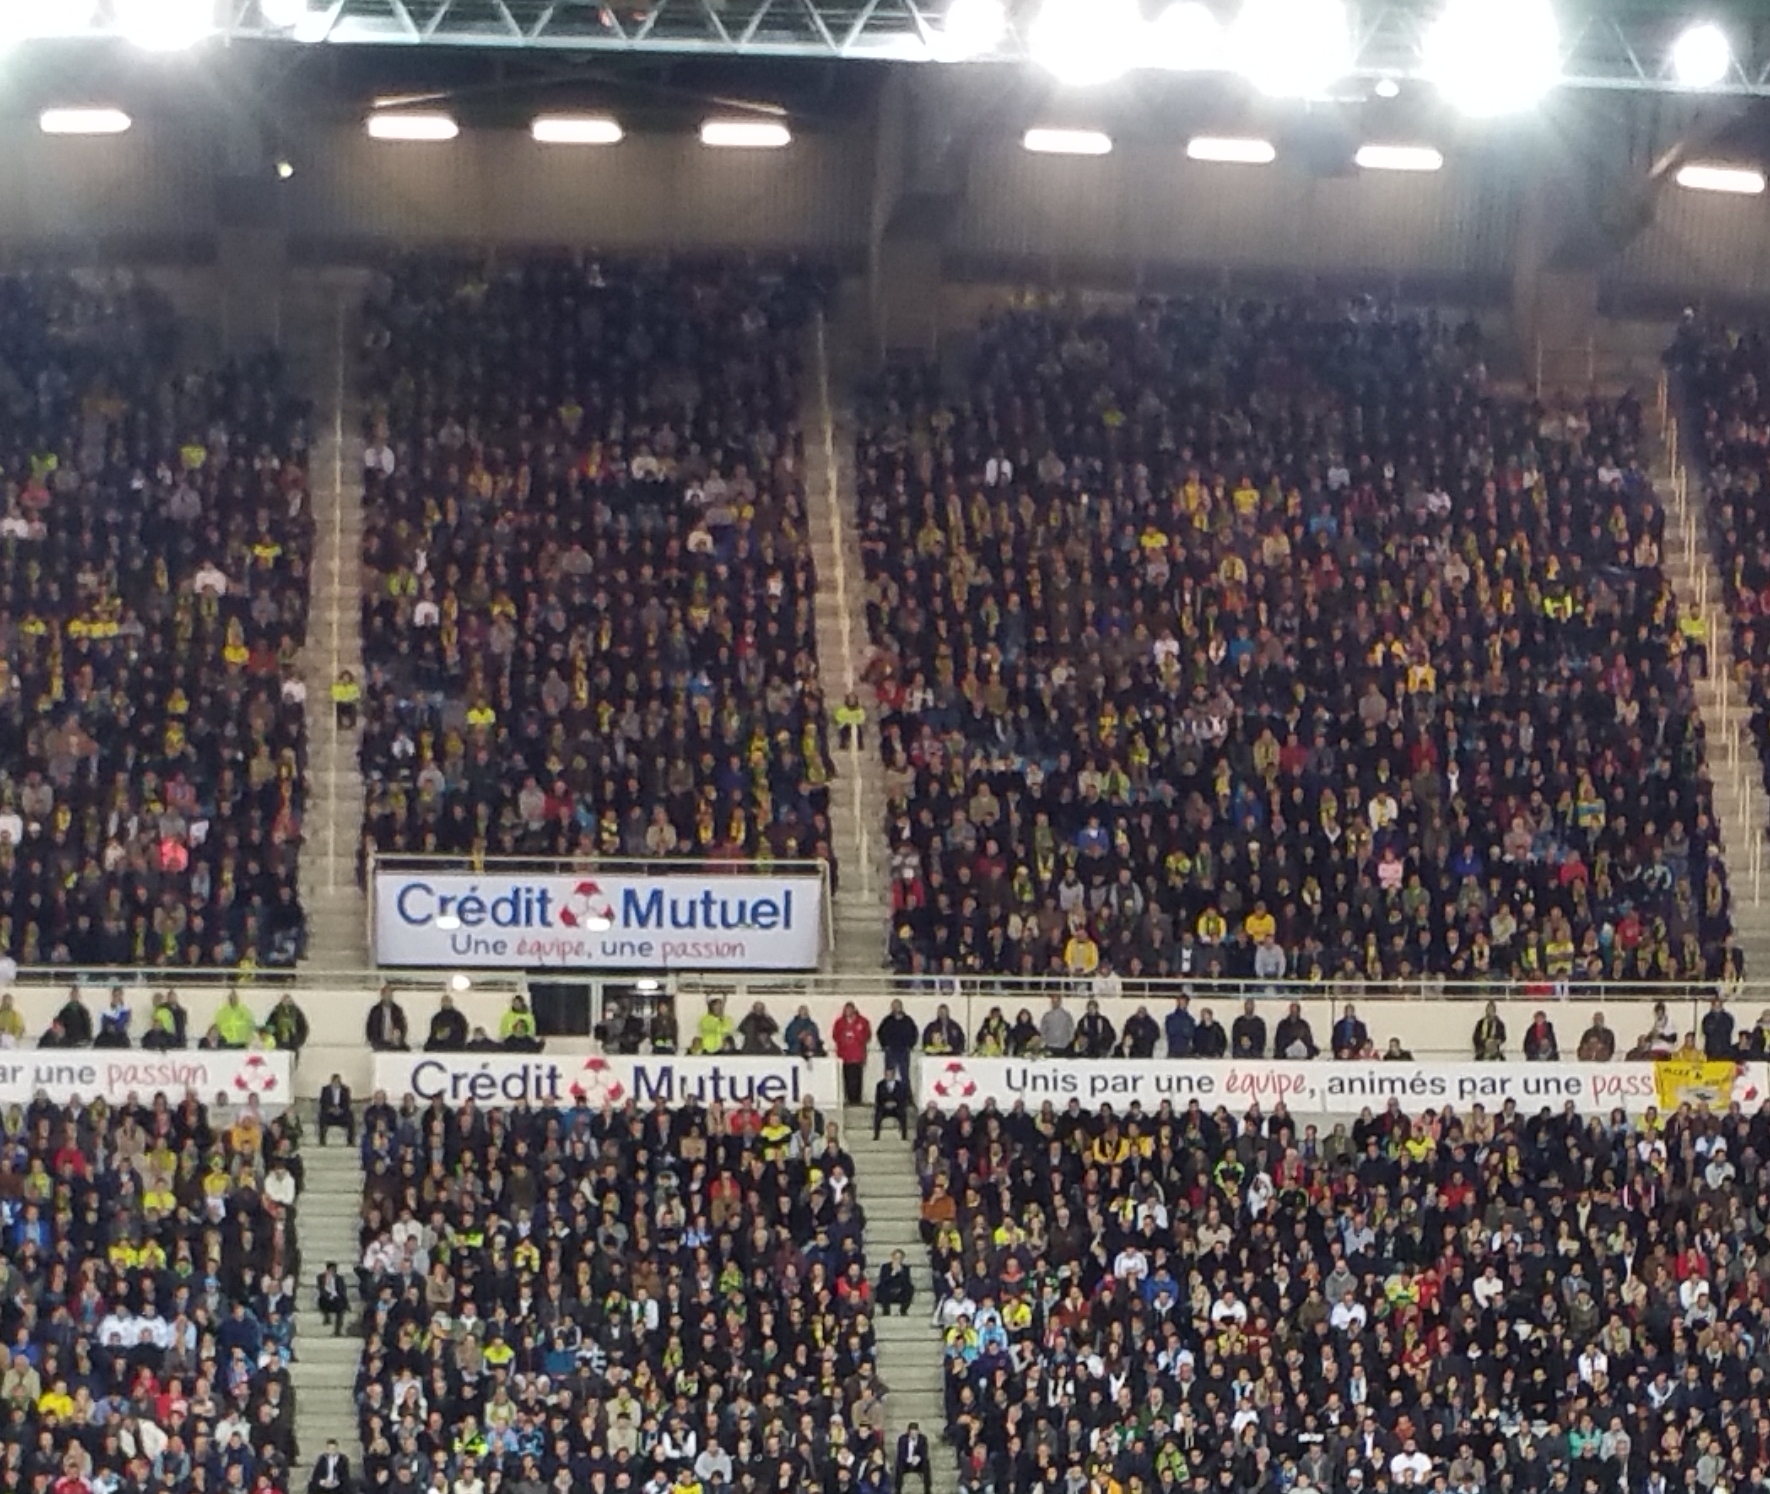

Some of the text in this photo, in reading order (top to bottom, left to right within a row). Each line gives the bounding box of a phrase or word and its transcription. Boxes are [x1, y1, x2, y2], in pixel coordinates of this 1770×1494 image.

[396, 881, 792, 930] Crédit Mutuel
[450, 933, 508, 956] Une
[601, 939, 654, 959] une
[661, 938, 746, 963] passion
[34, 1062, 96, 1086] une
[105, 1060, 209, 1096] passion
[410, 1060, 800, 1102] Crédit Mutuel
[1005, 1067, 1078, 1093] Unis
[1090, 1071, 1143, 1100] par
[1156, 1073, 1215, 1094] une
[1328, 1069, 1446, 1096] animés
[1458, 1074, 1513, 1102] par
[1523, 1076, 1582, 1096] une
[1592, 1076, 1657, 1106] pass
